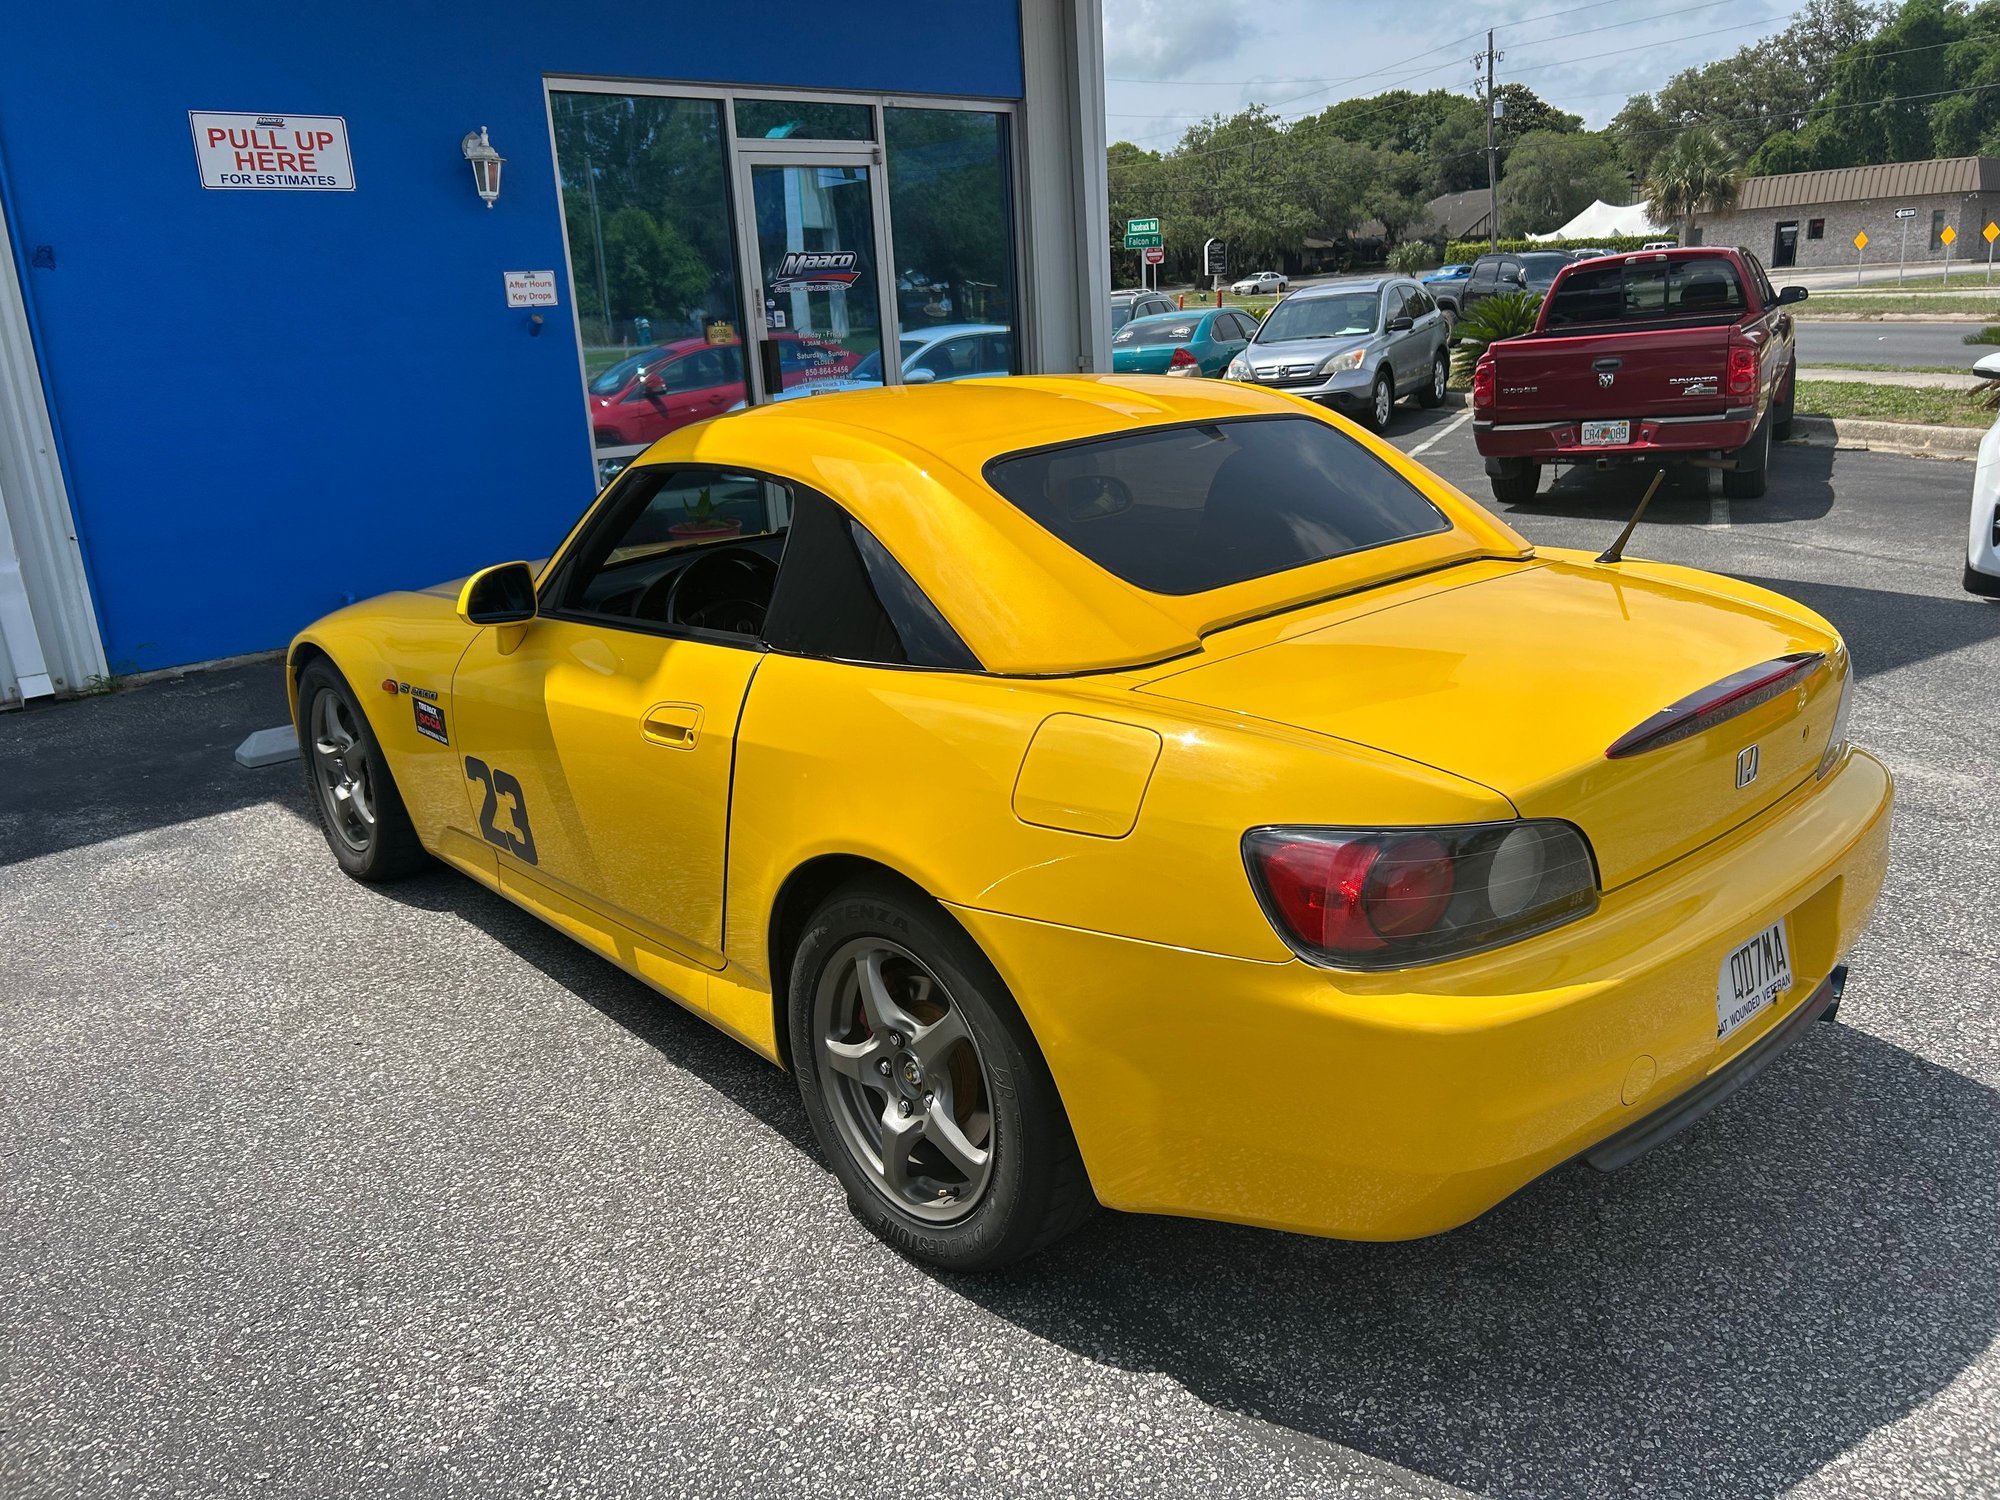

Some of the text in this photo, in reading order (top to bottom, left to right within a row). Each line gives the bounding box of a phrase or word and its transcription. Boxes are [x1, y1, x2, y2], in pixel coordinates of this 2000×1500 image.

[207, 128, 334, 151] PULL UP
[234, 151, 317, 173] HERE
[220, 173, 336, 186] FOR ESTIMATES
[1129, 236, 1159, 246] Falcon Pl
[509, 280, 552, 289] After Hours
[512, 292, 552, 302] Key Drops
[796, 352, 823, 360] Saturday
[1503, 386, 1538, 394] DODGE
[400, 682, 438, 700] S 2000
[420, 713, 442, 730] SCCA
[465, 755, 538, 866] 23
[1729, 995, 1760, 1027] WOUNDED
[1762, 973, 1791, 1001] VETERAN
